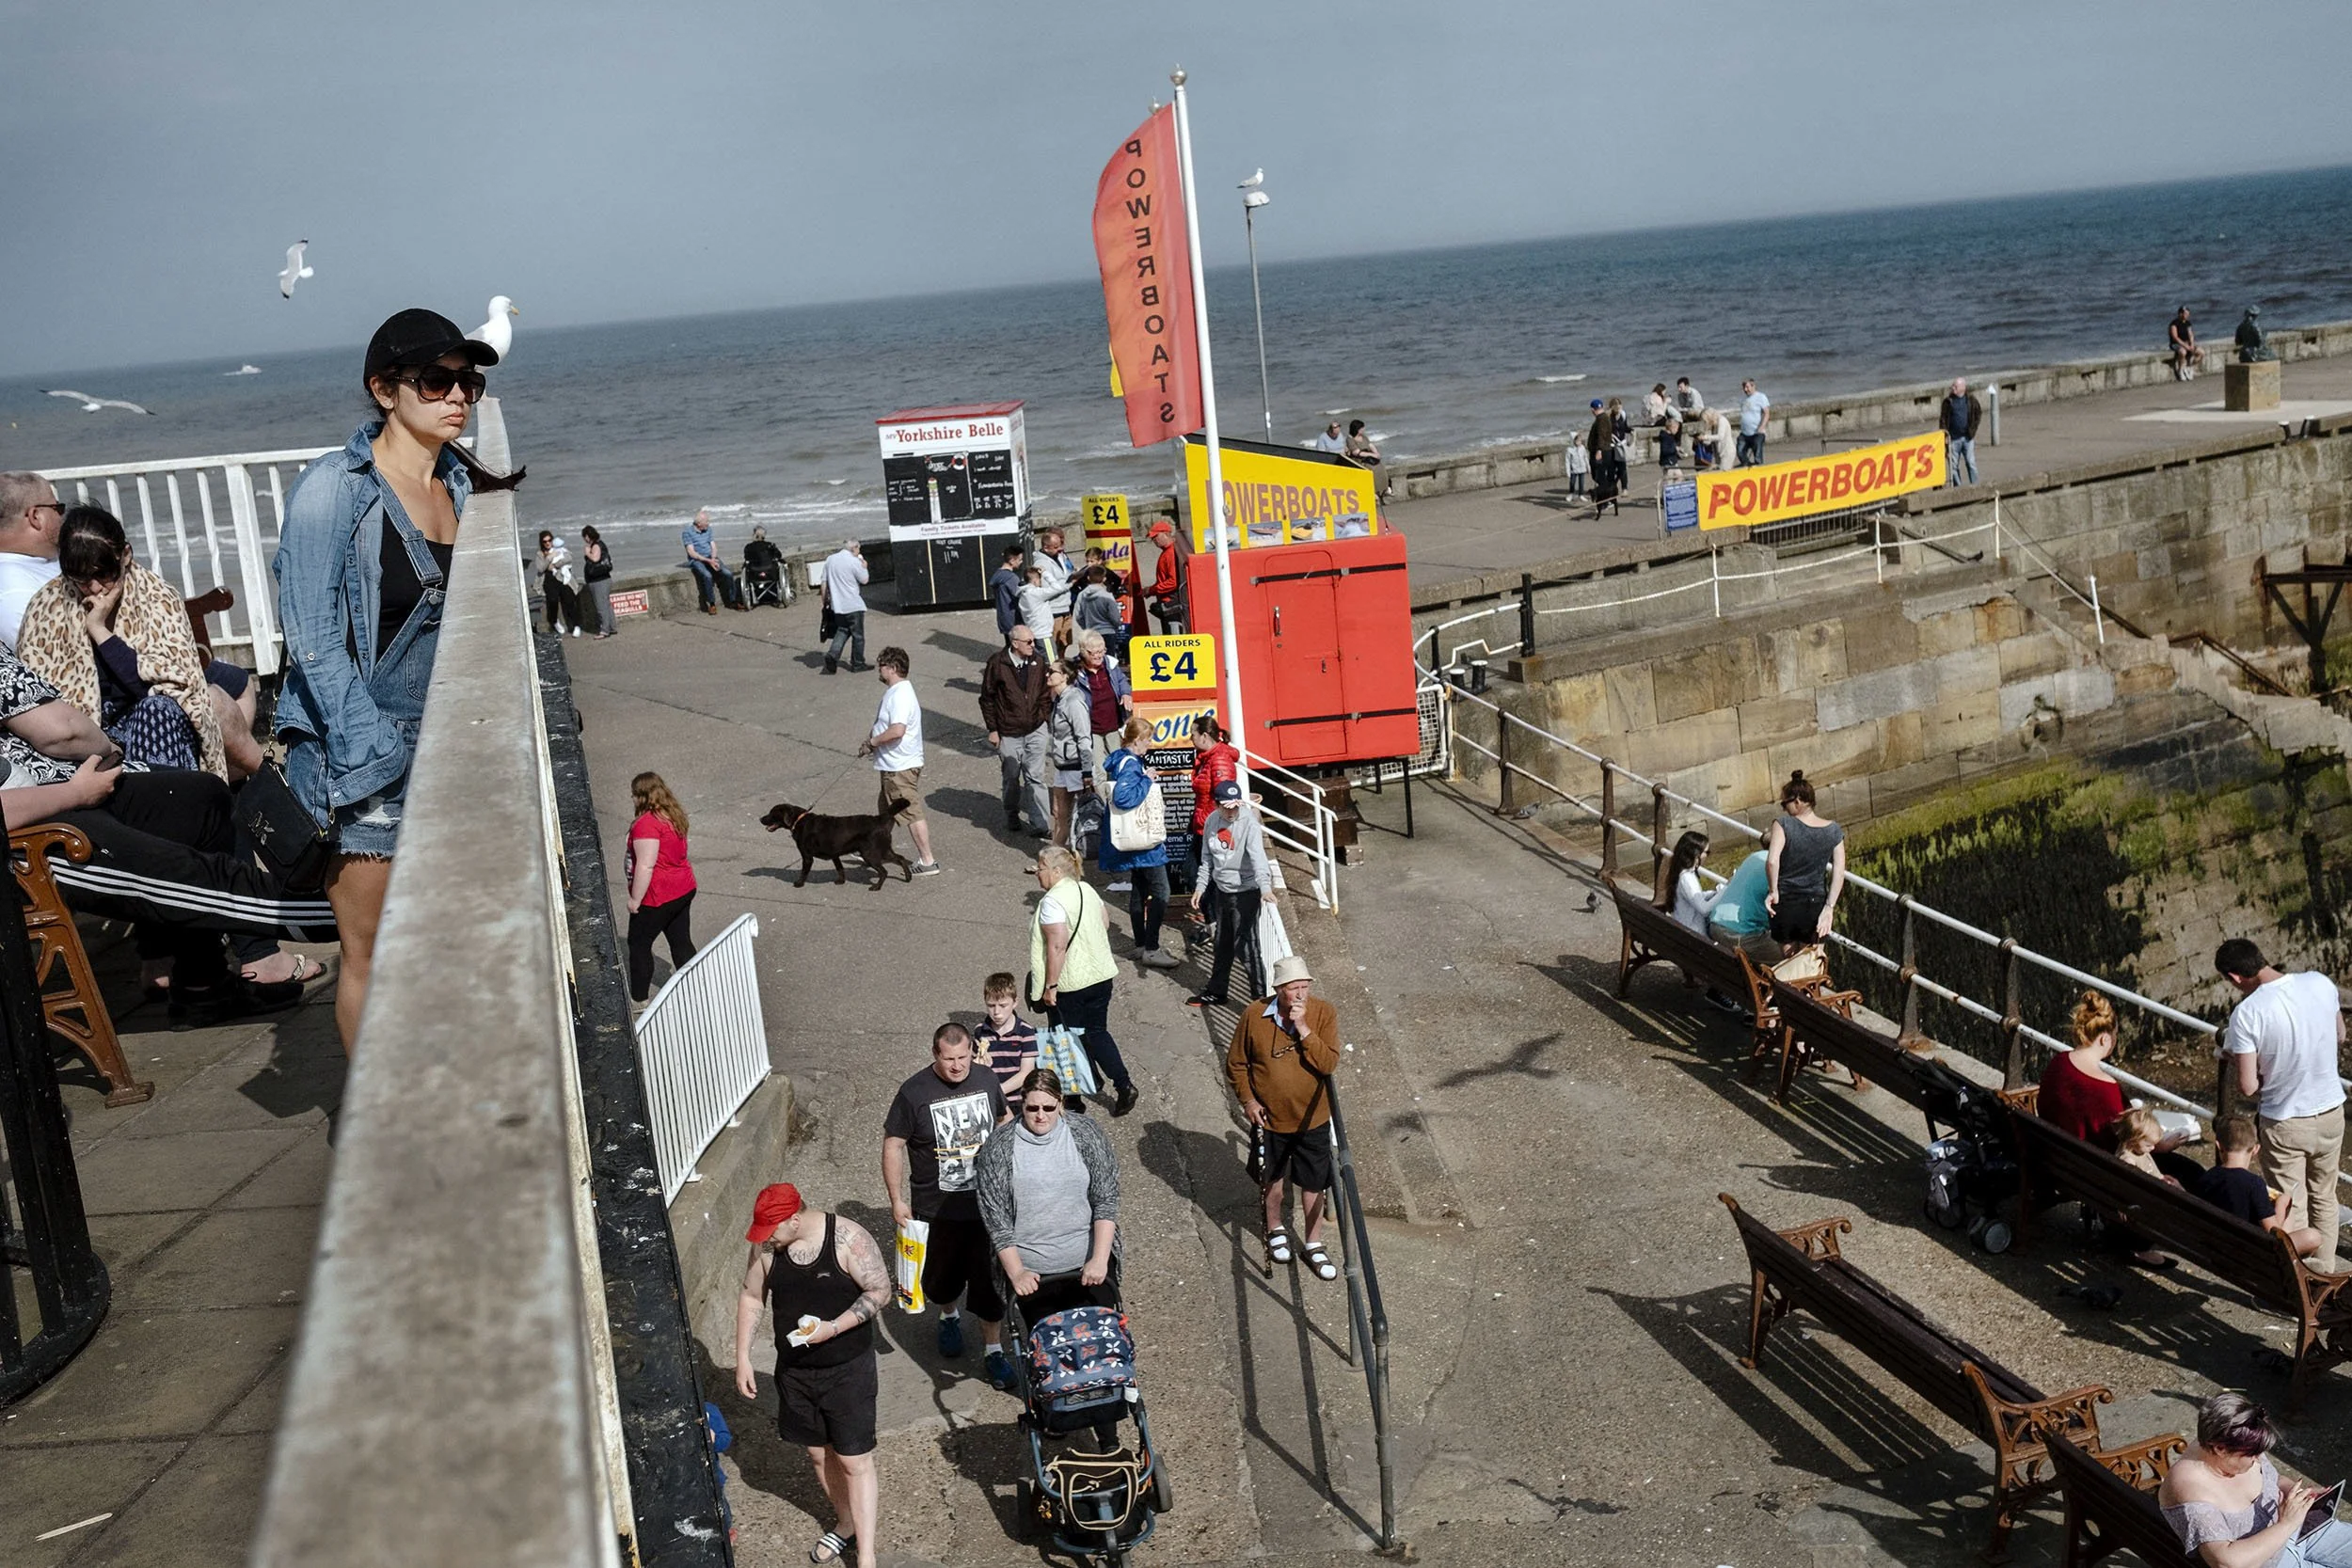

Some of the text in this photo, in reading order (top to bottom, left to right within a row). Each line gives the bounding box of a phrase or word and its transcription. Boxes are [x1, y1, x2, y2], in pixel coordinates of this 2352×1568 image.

[896, 426, 962, 443] Yorkshire
[968, 422, 1004, 437] Belle
[1708, 444, 1935, 519] POWERBOATS
[1092, 505, 1120, 525] £4
[1165, 639, 1200, 647] RIDERS
[1150, 651, 1198, 682] £4
[934, 1099, 989, 1132] NEW
